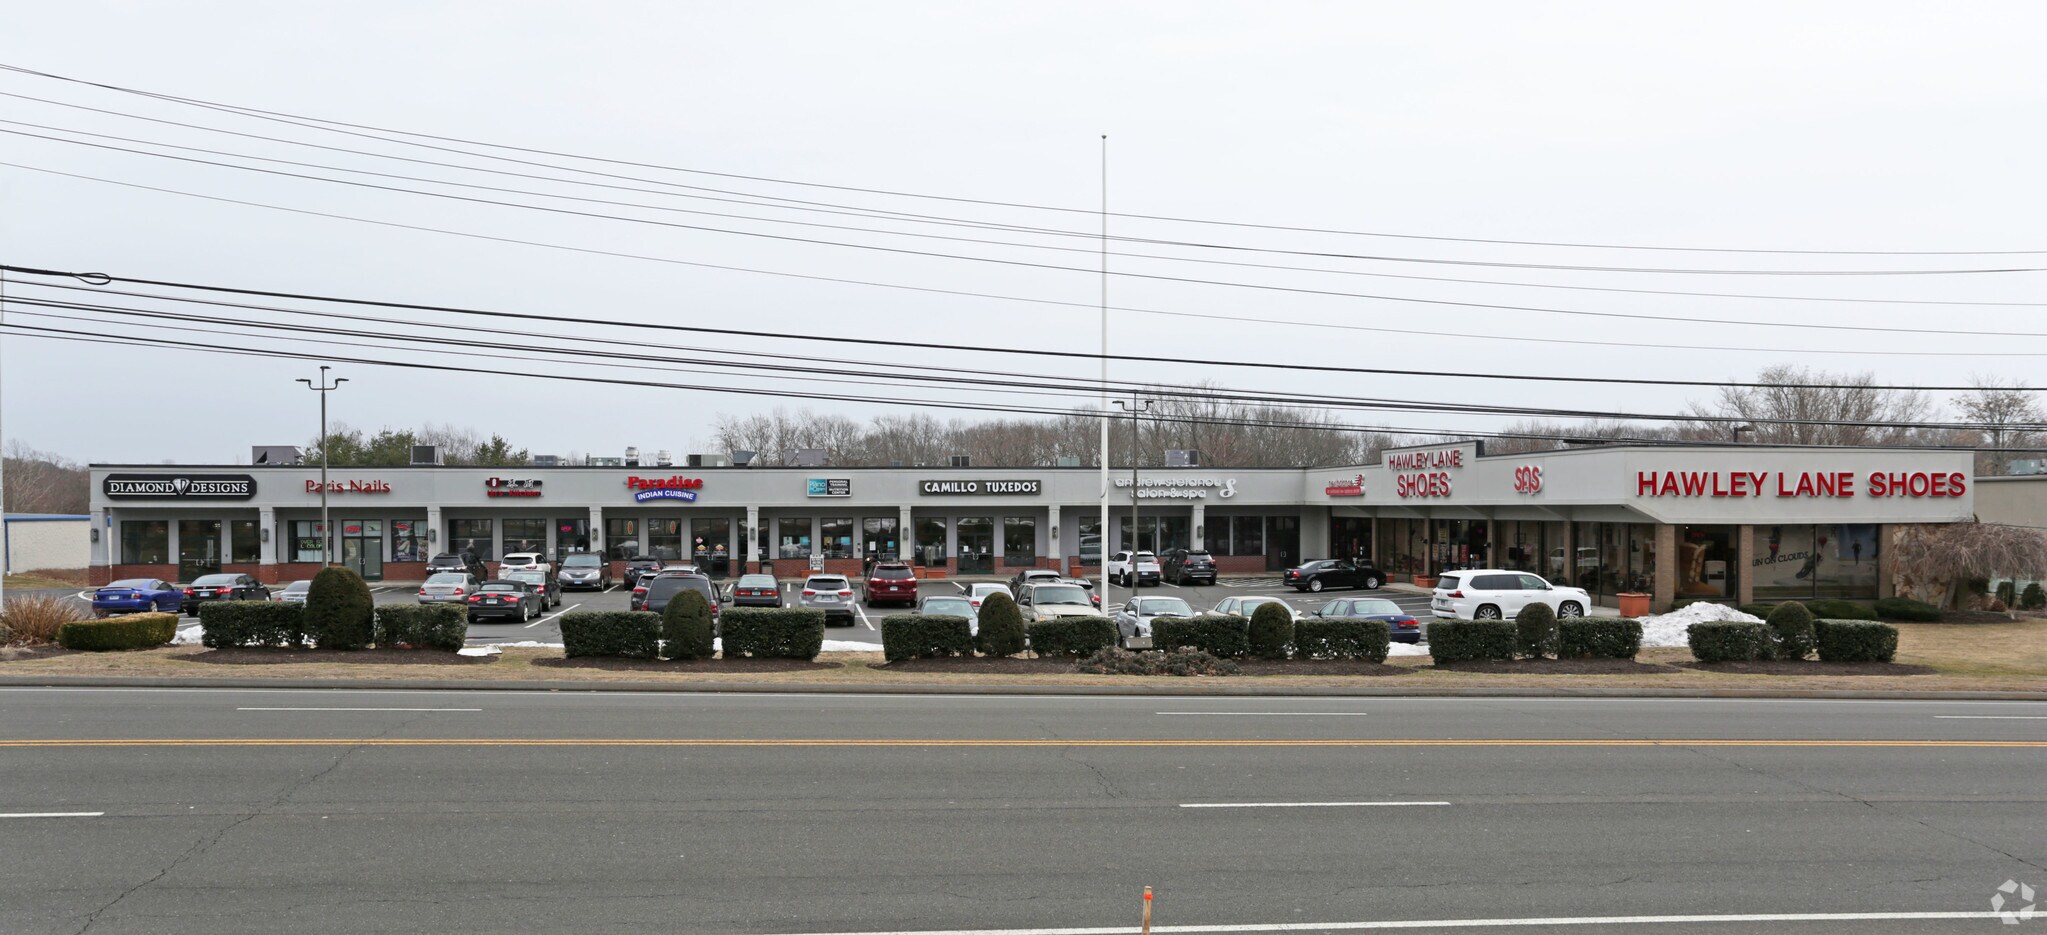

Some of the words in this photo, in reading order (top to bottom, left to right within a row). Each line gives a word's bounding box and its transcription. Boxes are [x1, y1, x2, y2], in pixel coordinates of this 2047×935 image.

[1389, 452, 1429, 470] HAWLEY
[1431, 450, 1462, 468] LANE
[305, 480, 344, 493] Paris
[350, 480, 391, 493] Nails
[627, 475, 704, 490] Paradise
[1397, 472, 1450, 497] SHOES
[1514, 466, 1541, 494] SAS
[1637, 471, 1768, 497] HAWLEY
[1777, 471, 1855, 497] LANE
[1868, 471, 1967, 497] SHOES
[110, 483, 175, 493] DIAMOND
[191, 483, 248, 493] DESIGNS
[924, 482, 977, 493] CAMILLO
[986, 482, 1037, 493] TUXEDOS
[1182, 489, 1207, 500] spa
[637, 490, 663, 500] INDIAN
[665, 490, 694, 500] CUISINE
[1764, 557, 1776, 565] ON
[1778, 551, 1809, 562] CLOUDS
